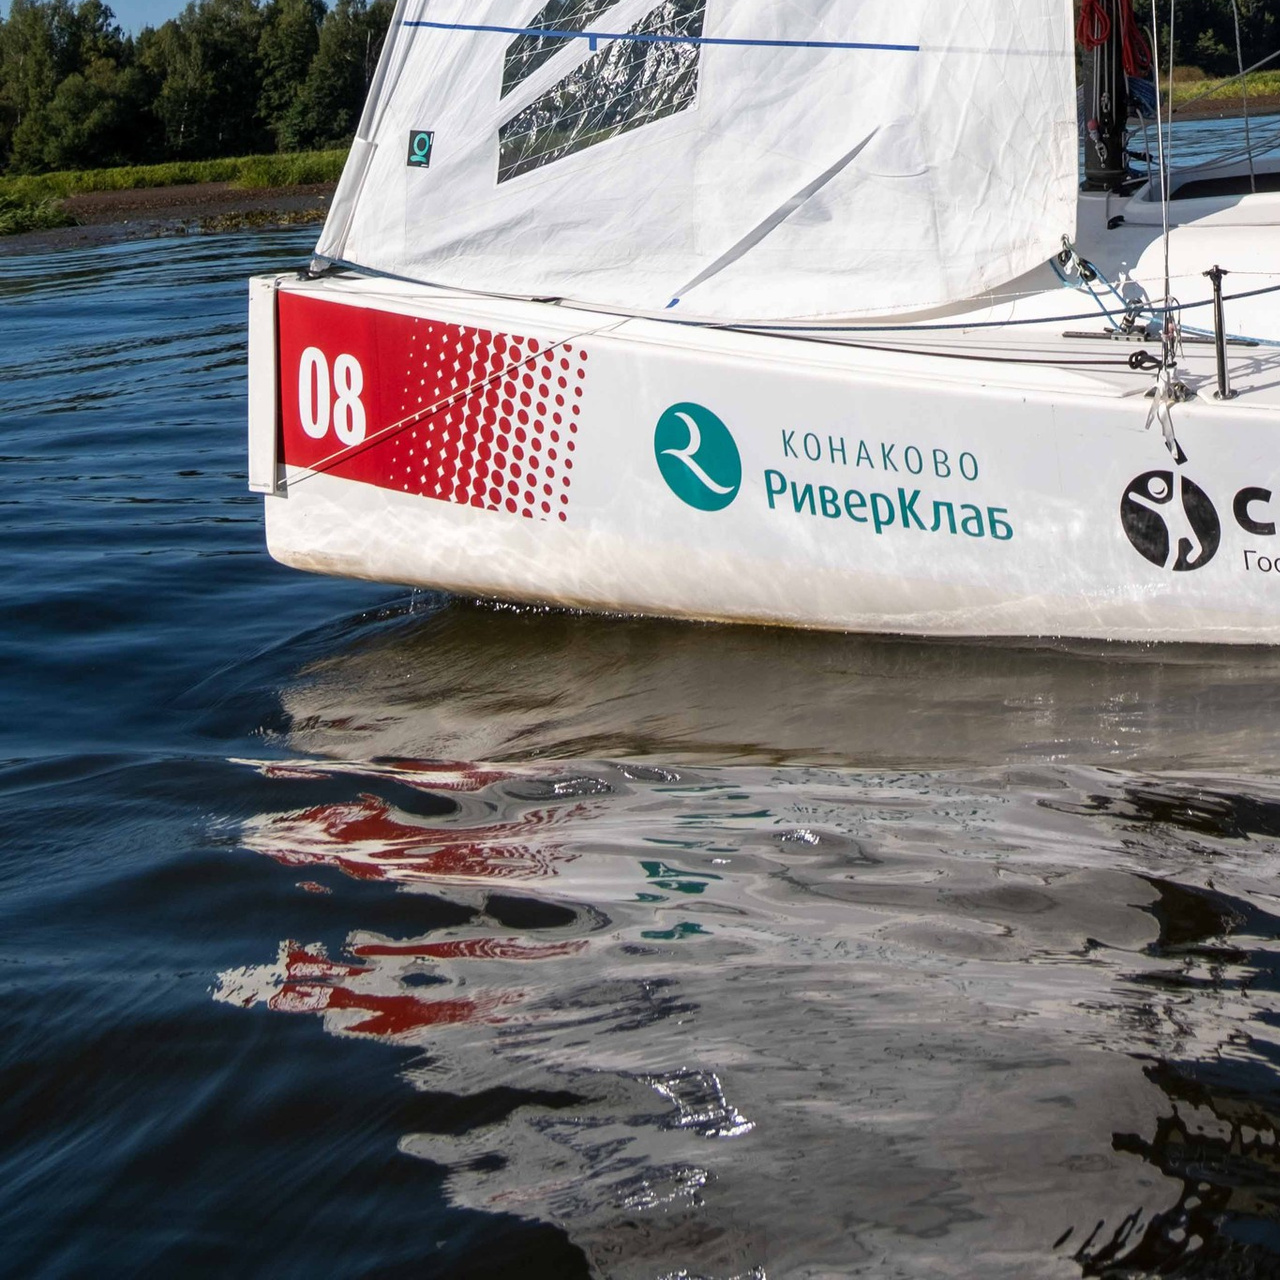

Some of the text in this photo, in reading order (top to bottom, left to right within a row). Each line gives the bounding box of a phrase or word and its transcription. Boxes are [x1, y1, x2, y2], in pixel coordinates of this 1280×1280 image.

[298, 346, 366, 447] 08
[781, 429, 979, 481] КОНАКОВО
[764, 469, 1014, 541] РиверКлаб
